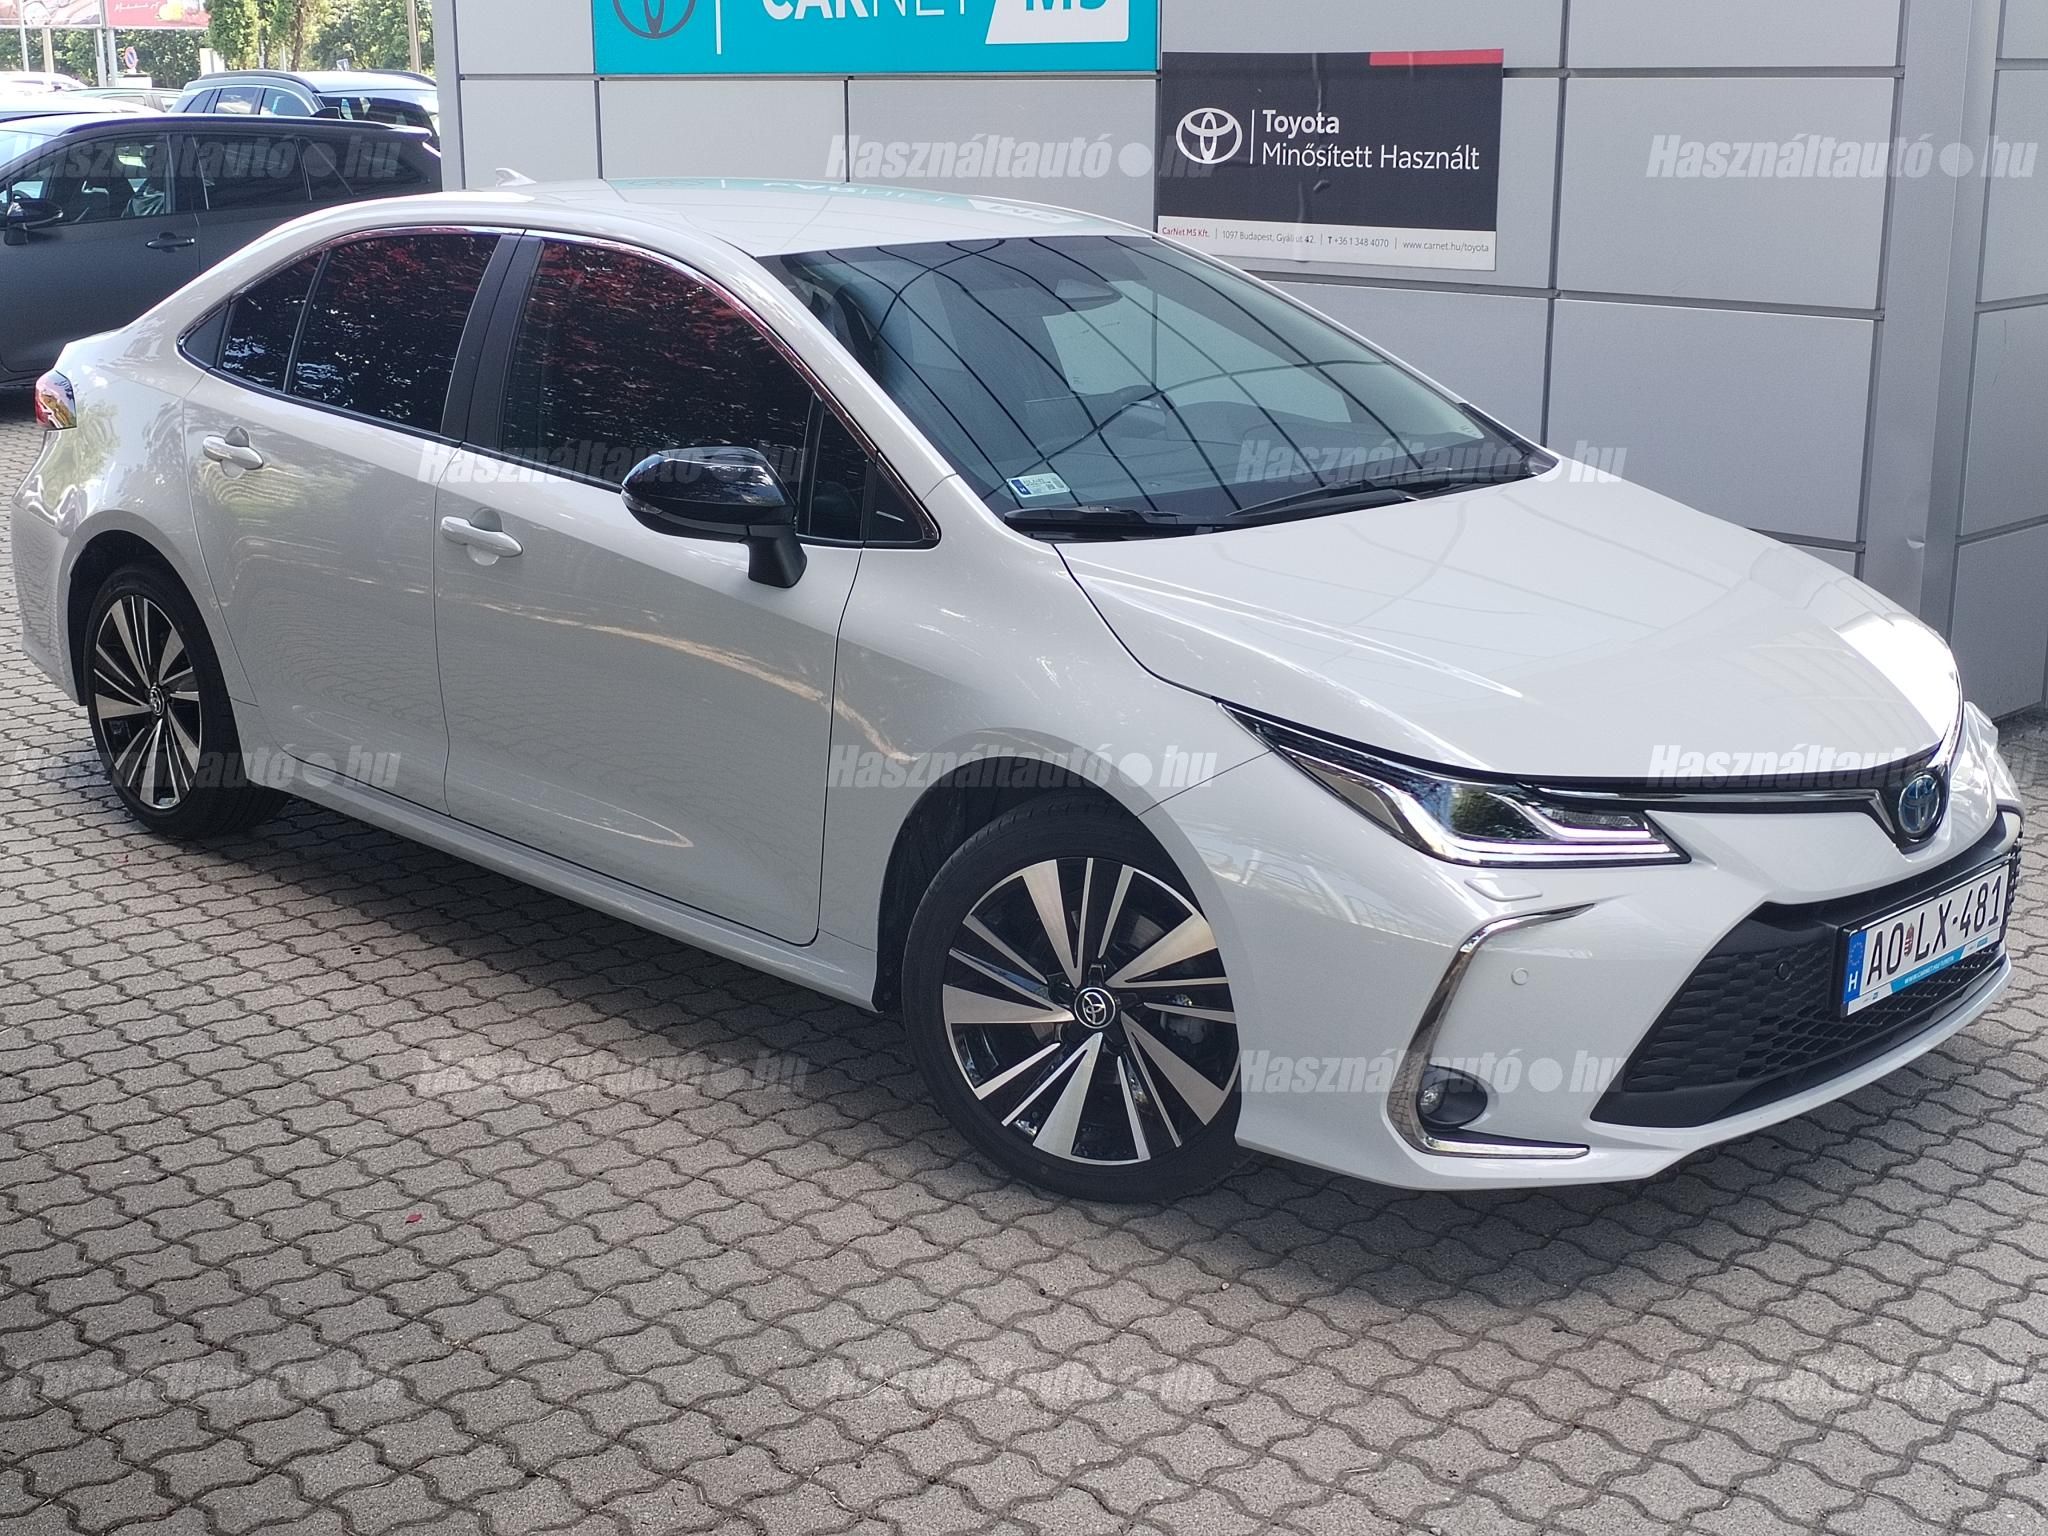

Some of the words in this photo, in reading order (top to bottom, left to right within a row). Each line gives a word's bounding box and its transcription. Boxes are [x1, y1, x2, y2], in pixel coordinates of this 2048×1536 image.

[1262, 109, 1340, 139] Toyota
[1262, 142, 1372, 169] Minősített
[1379, 144, 1480, 171] Használt
[1162, 227, 1185, 236] CarNet
[1222, 230, 1238, 239] 1097
[1354, 238, 1369, 247] 348
[1370, 238, 1389, 248] 4070
[1403, 240, 1489, 253] www.carnet.hu/toyota
[1847, 971, 1859, 992] H
